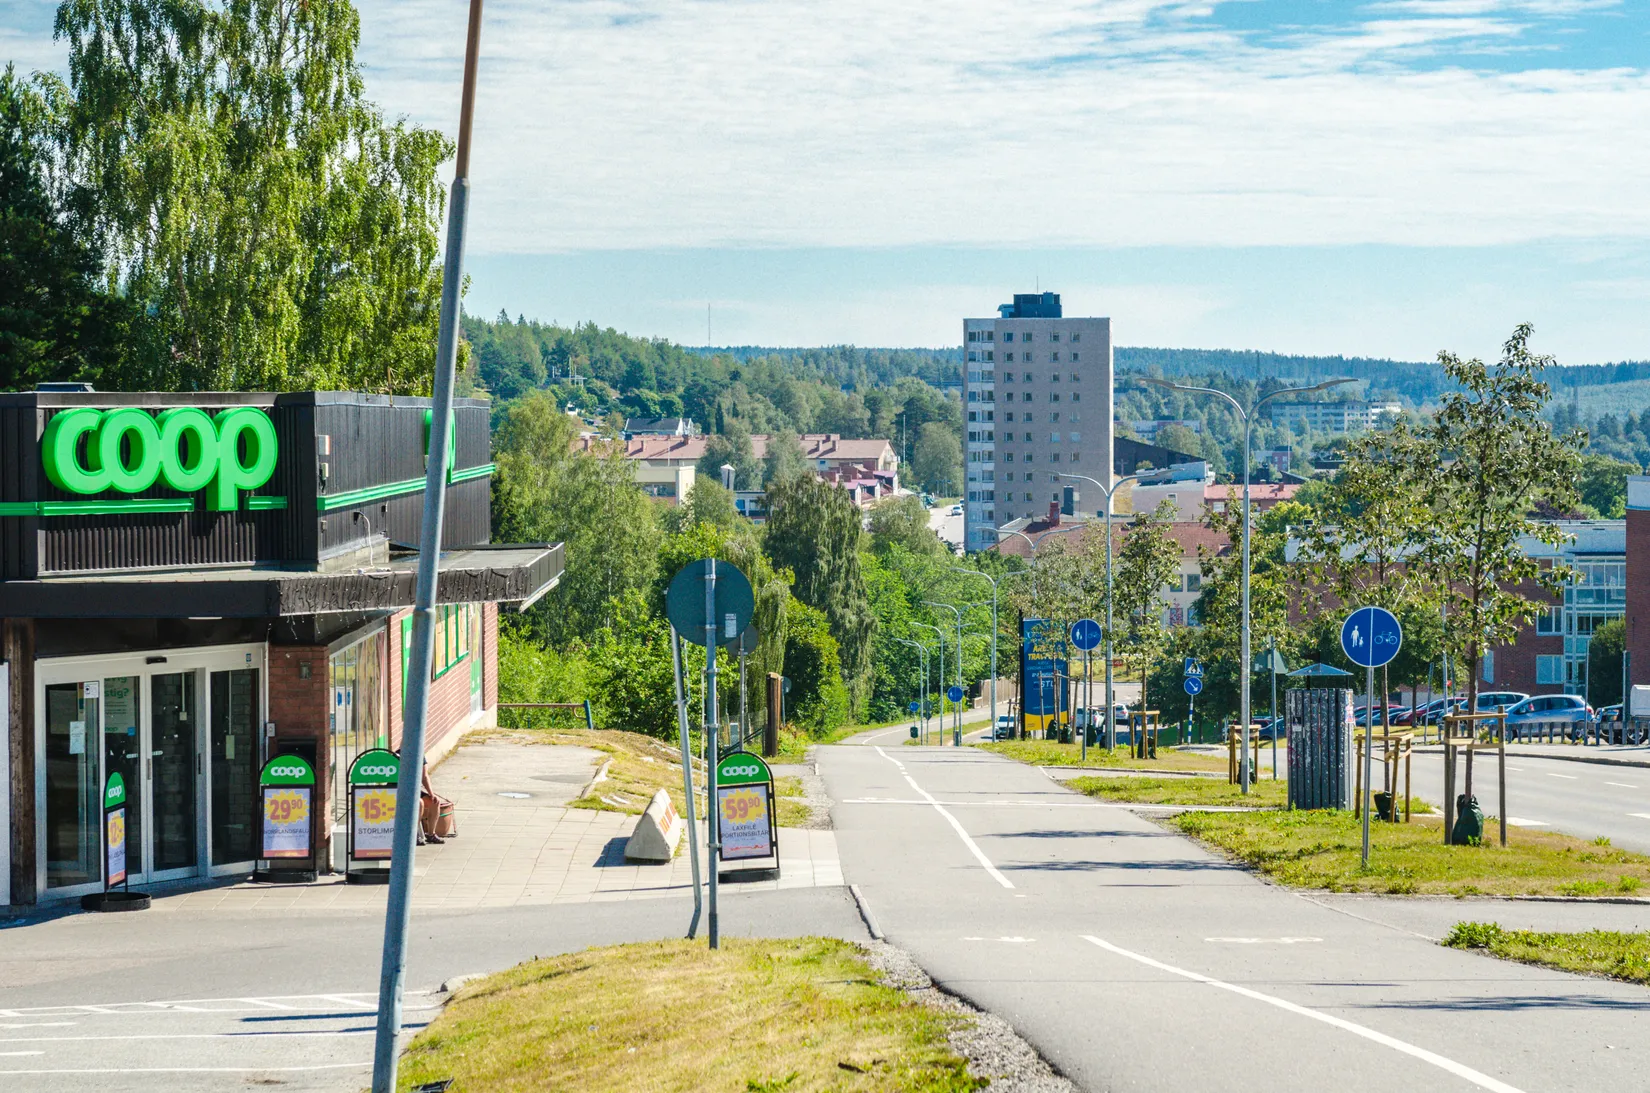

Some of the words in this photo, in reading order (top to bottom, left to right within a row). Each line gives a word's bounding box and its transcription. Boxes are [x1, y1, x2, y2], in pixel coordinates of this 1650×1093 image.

[42, 407, 278, 511] coop
[270, 766, 306, 778] coop
[360, 765, 397, 777] coop
[722, 765, 760, 777] coop
